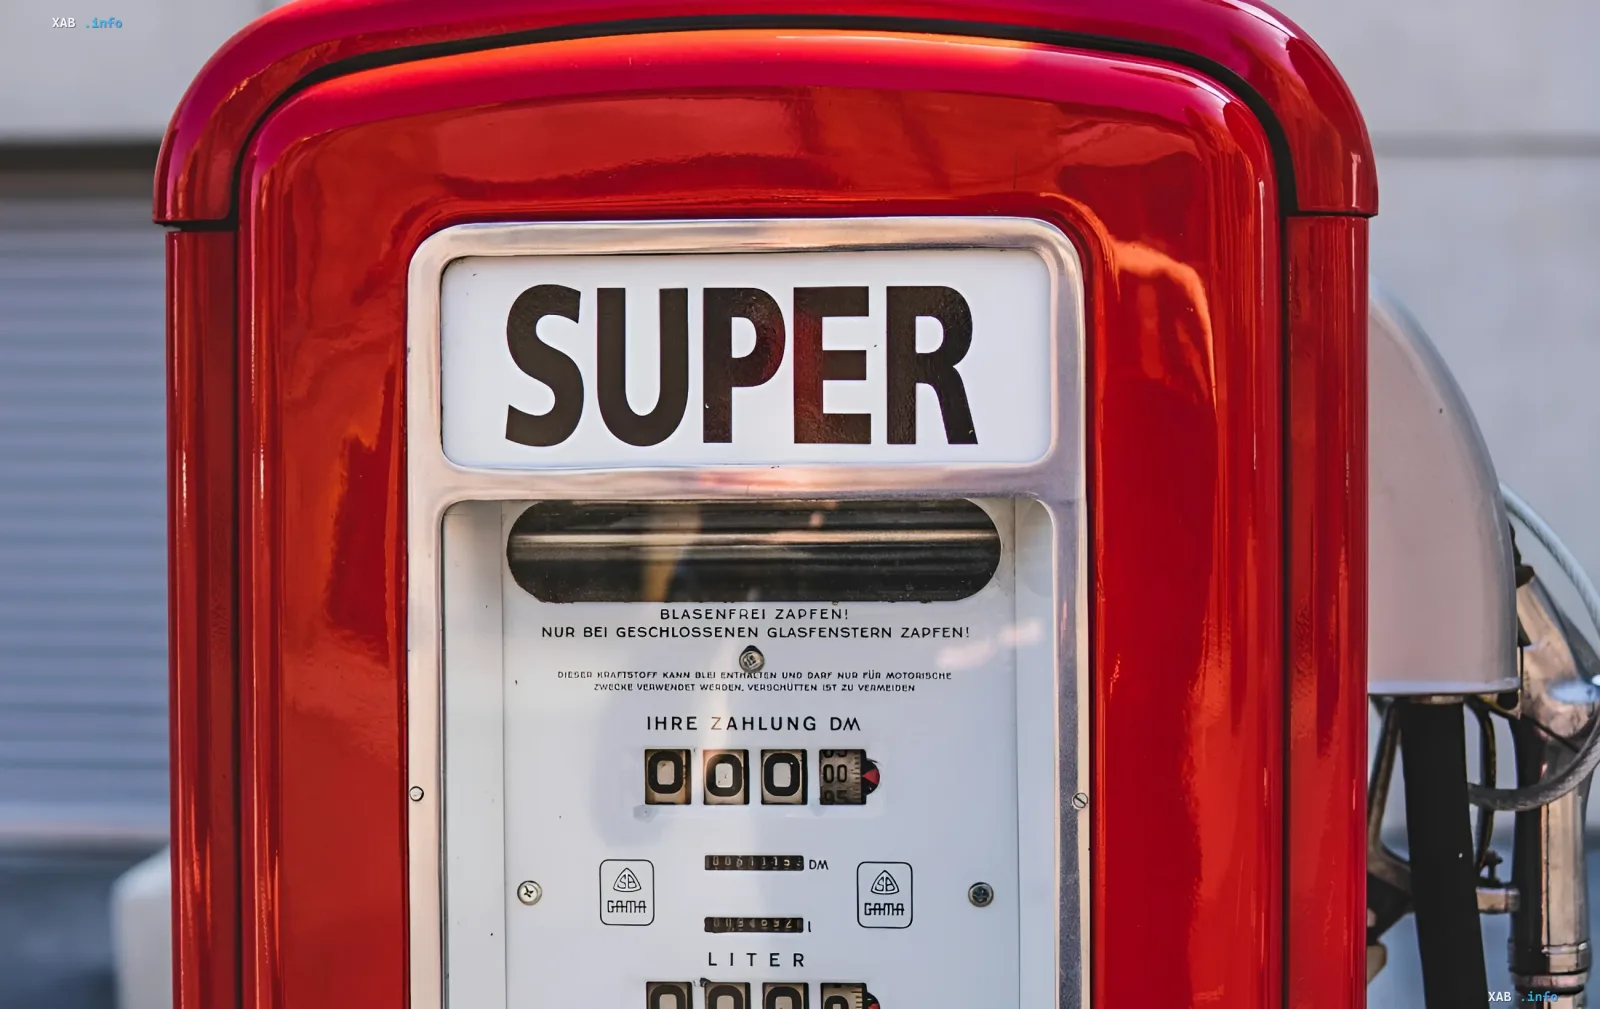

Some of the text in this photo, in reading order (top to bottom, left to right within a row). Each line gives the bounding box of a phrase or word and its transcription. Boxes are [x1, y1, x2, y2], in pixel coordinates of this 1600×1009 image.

[504, 283, 979, 447] SUPER
[660, 608, 848, 620] BLASENFREI ZAPFEN!
[541, 626, 970, 638] NUR BEI GESCHLOSSENEN GLASFENSTERN ZAPFEN!
[557, 669, 952, 681] DIESER KRAFTSTOFF KANN BLEI ENTHALTEN UND DARF NUR FÜR MOTORISCHE
[594, 684, 633, 692] ZWECKE
[636, 684, 696, 692] VERWENDET
[747, 683, 818, 692] VERSCHÜTTEN
[822, 684, 837, 692] IST
[841, 684, 854, 692] ZU
[857, 684, 915, 692] VERMEIDEN
[647, 716, 861, 731] IHRE ZAHLUNG DM
[809, 860, 829, 870] DM
[607, 900, 647, 914] GAMA
[864, 902, 905, 916] GAMA
[708, 951, 805, 967] LITER
